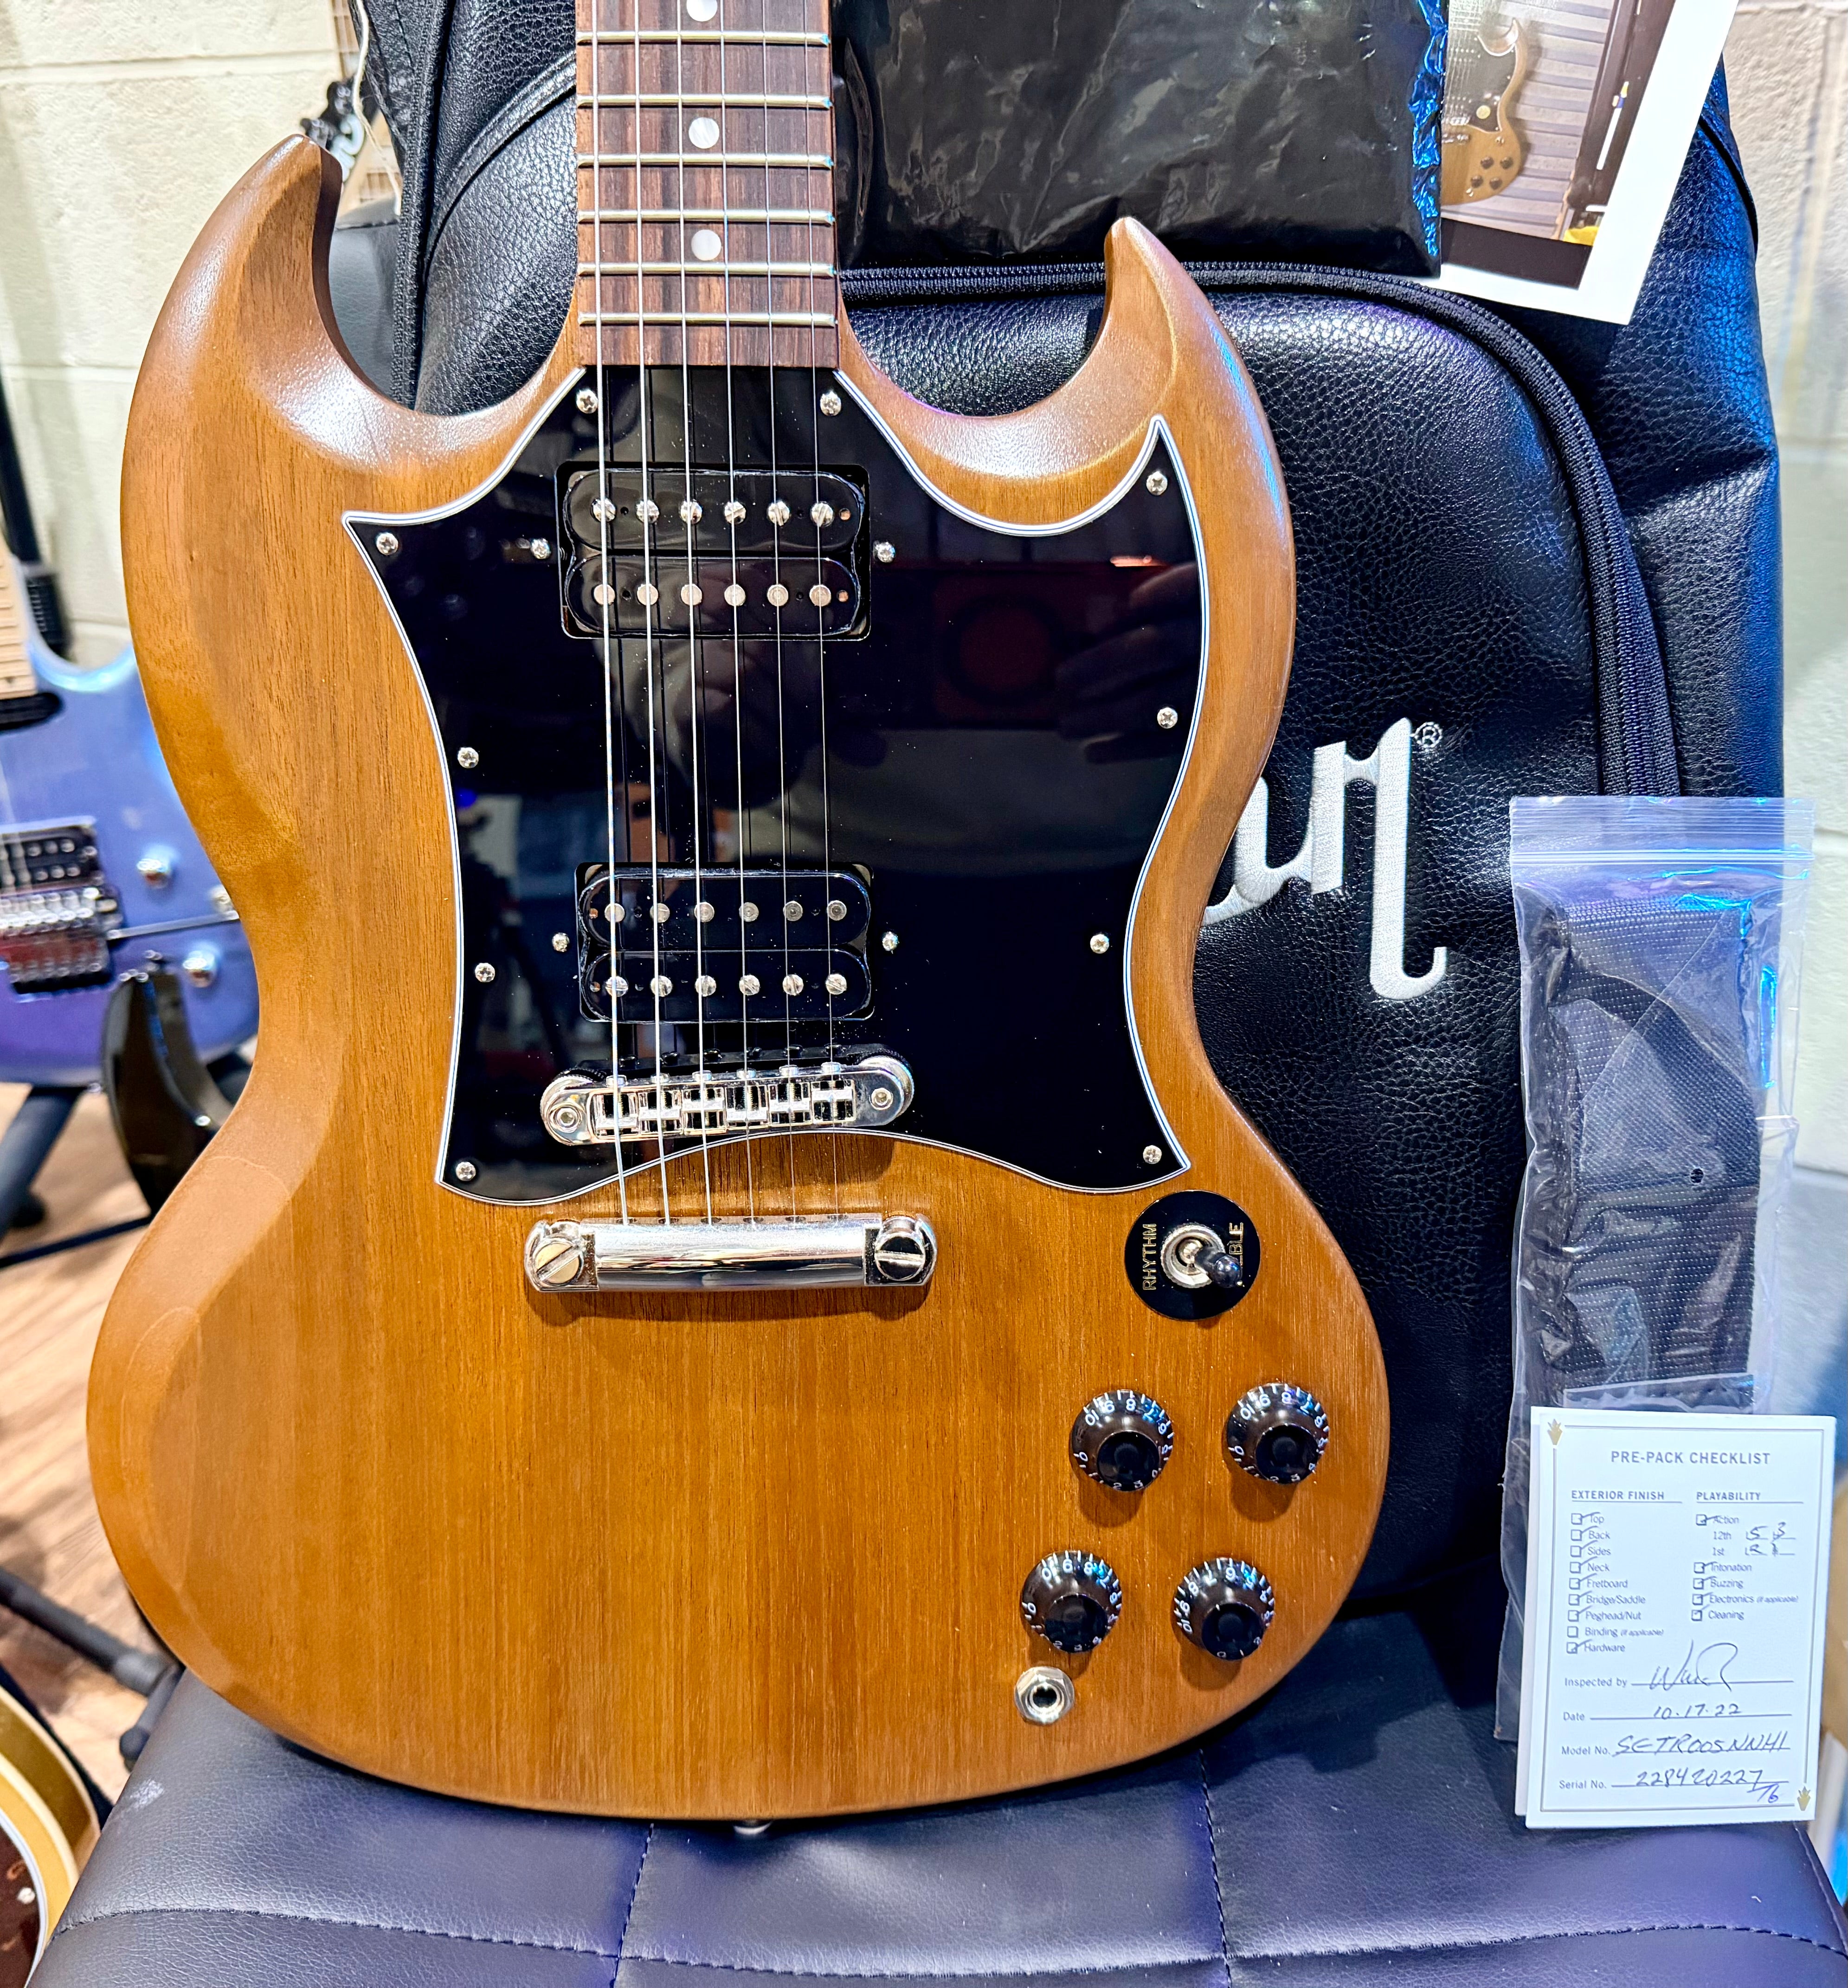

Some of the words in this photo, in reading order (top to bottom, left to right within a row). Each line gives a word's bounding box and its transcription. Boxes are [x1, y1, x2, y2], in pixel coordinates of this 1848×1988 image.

[1229, 1222, 1244, 1266] BLE
[1142, 1223, 1157, 1290] RHYTHM
[1611, 1451, 1684, 1464] PRE-PACK
[1689, 1452, 1771, 1464] CHECKLIST
[1571, 1490, 1624, 1499] EXTERIOR
[1628, 1491, 1665, 1500] FINISH
[1696, 1491, 1761, 1500] PLAYABILITY
[1590, 1514, 1605, 1524] Top
[1713, 1515, 1739, 1524] Action
[1588, 1530, 1610, 1539] Back
[1713, 1531, 1732, 1540] 12th
[1587, 1546, 1611, 1556] Sides
[1712, 1547, 1725, 1556] 1st
[1587, 1562, 1610, 1572] Neck
[1711, 1563, 1752, 1572] Intonation
[1587, 1579, 1628, 1588] Fretboard
[1710, 1579, 1744, 1589] Buzzing
[1586, 1594, 1646, 1605] Bridge/Saddle
[1709, 1594, 1754, 1603] Electronics
[1585, 1611, 1642, 1621] Peghead/Nut
[1708, 1610, 1745, 1620] Cleaning
[1585, 1627, 1618, 1637] Binding
[1584, 1643, 1625, 1652] Hardware
[1564, 1677, 1612, 1688] Inspected
[1616, 1678, 1628, 1688] by
[1563, 1712, 1585, 1721] Date
[1561, 1745, 1590, 1756] Model
[1593, 1746, 1610, 1755] No.
[1558, 1779, 1587, 1790] Serial
[1590, 1780, 1607, 1789] No.
